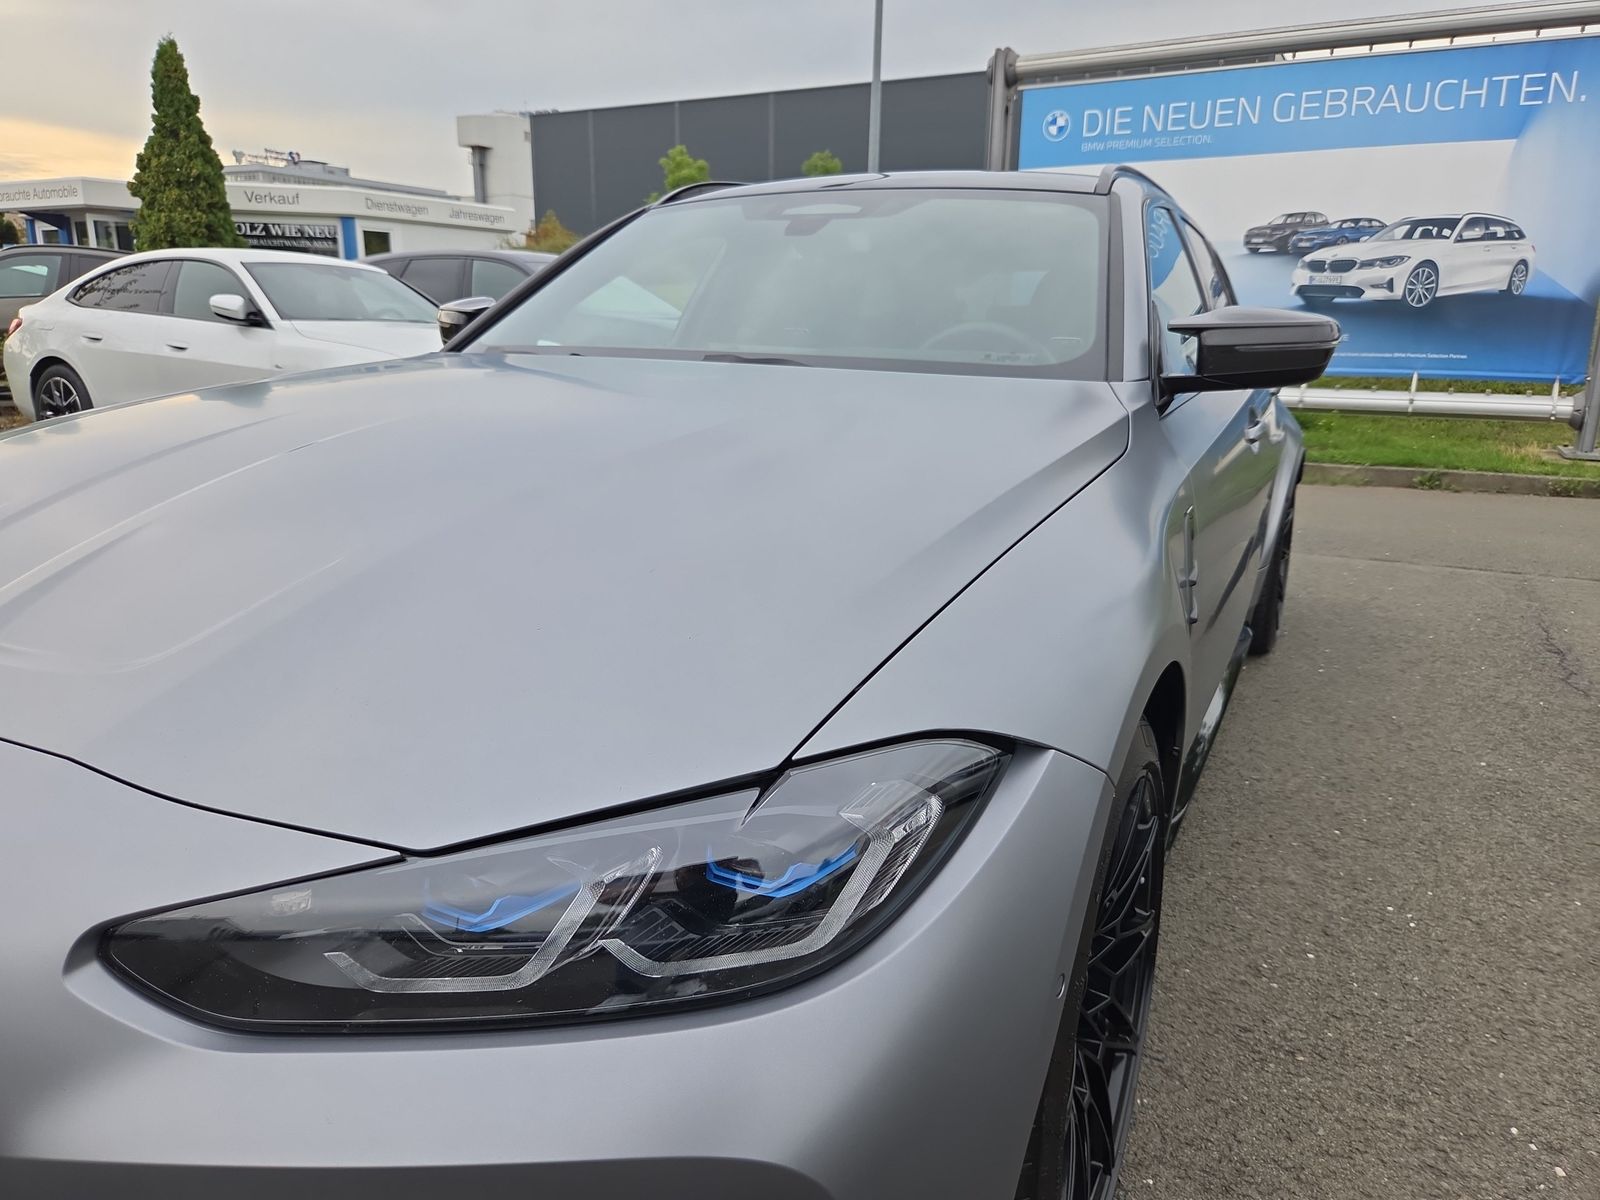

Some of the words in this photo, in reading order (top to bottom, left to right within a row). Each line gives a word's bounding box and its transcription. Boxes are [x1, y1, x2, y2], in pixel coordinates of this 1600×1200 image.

[1082, 106, 1134, 138] DIE
[1142, 95, 1262, 133] NEUEN
[1272, 70, 1588, 123] GEBRAUCHTEN.
[1081, 142, 1106, 153] BMW
[1106, 138, 1152, 151] PREMIUM
[33, 185, 78, 200] Automobile
[244, 190, 301, 206] Verkauf
[365, 198, 429, 217] Dienstwagen
[449, 207, 505, 225] Jahreswagen
[268, 223, 301, 238] WIE
